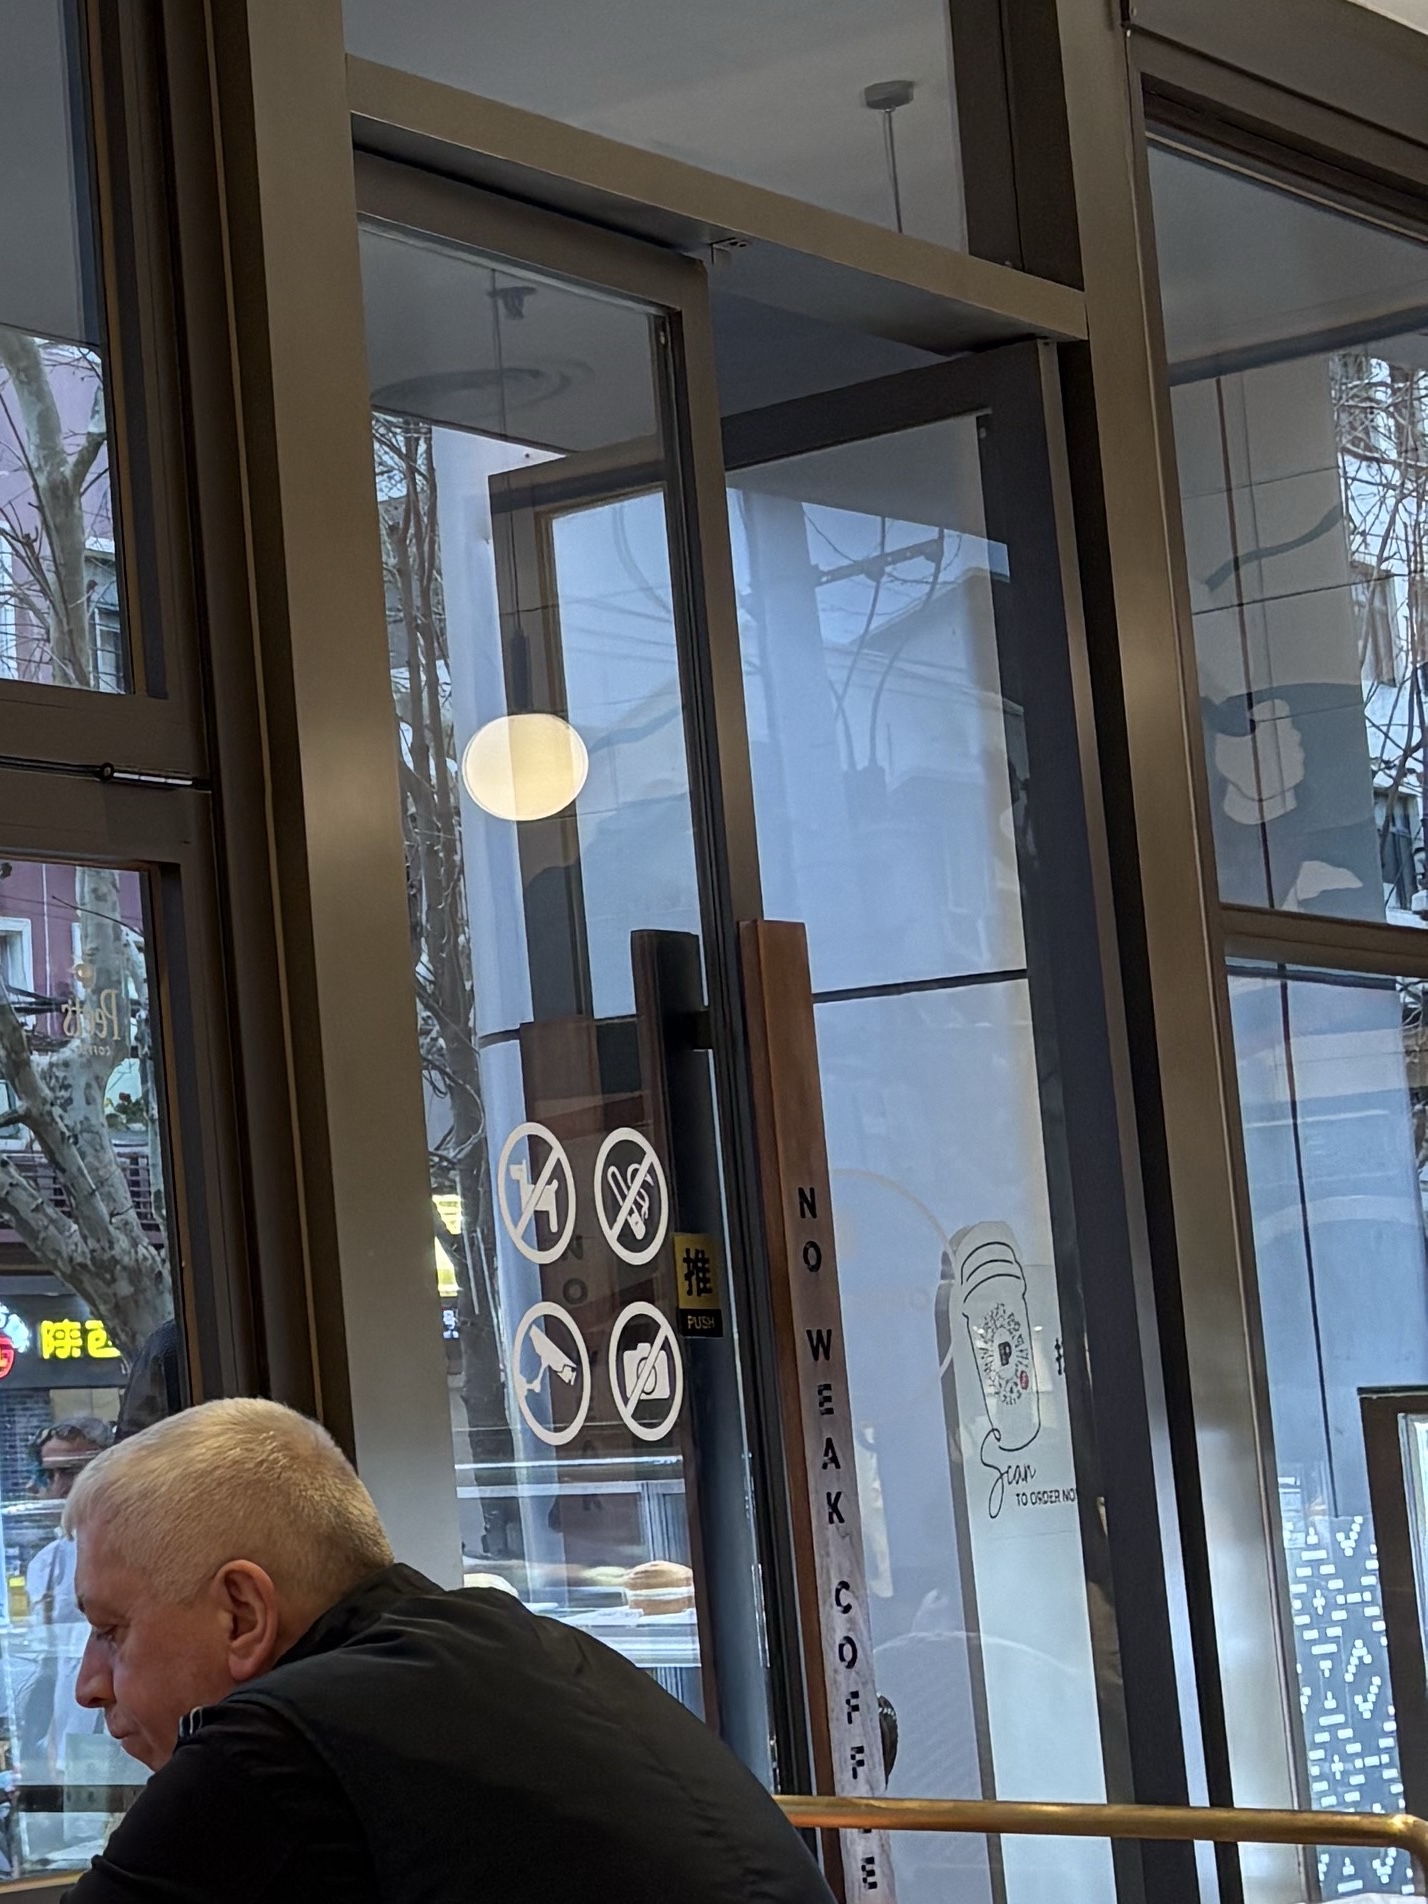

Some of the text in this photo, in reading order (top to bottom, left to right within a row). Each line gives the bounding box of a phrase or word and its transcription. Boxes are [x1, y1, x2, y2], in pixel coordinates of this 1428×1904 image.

[682, 1247, 713, 1297] 推
[687, 1314, 716, 1330] PUSH
[1015, 1487, 1078, 1507] TO ORDER NO
[797, 1186, 878, 1892] NO WEAK COFFE
